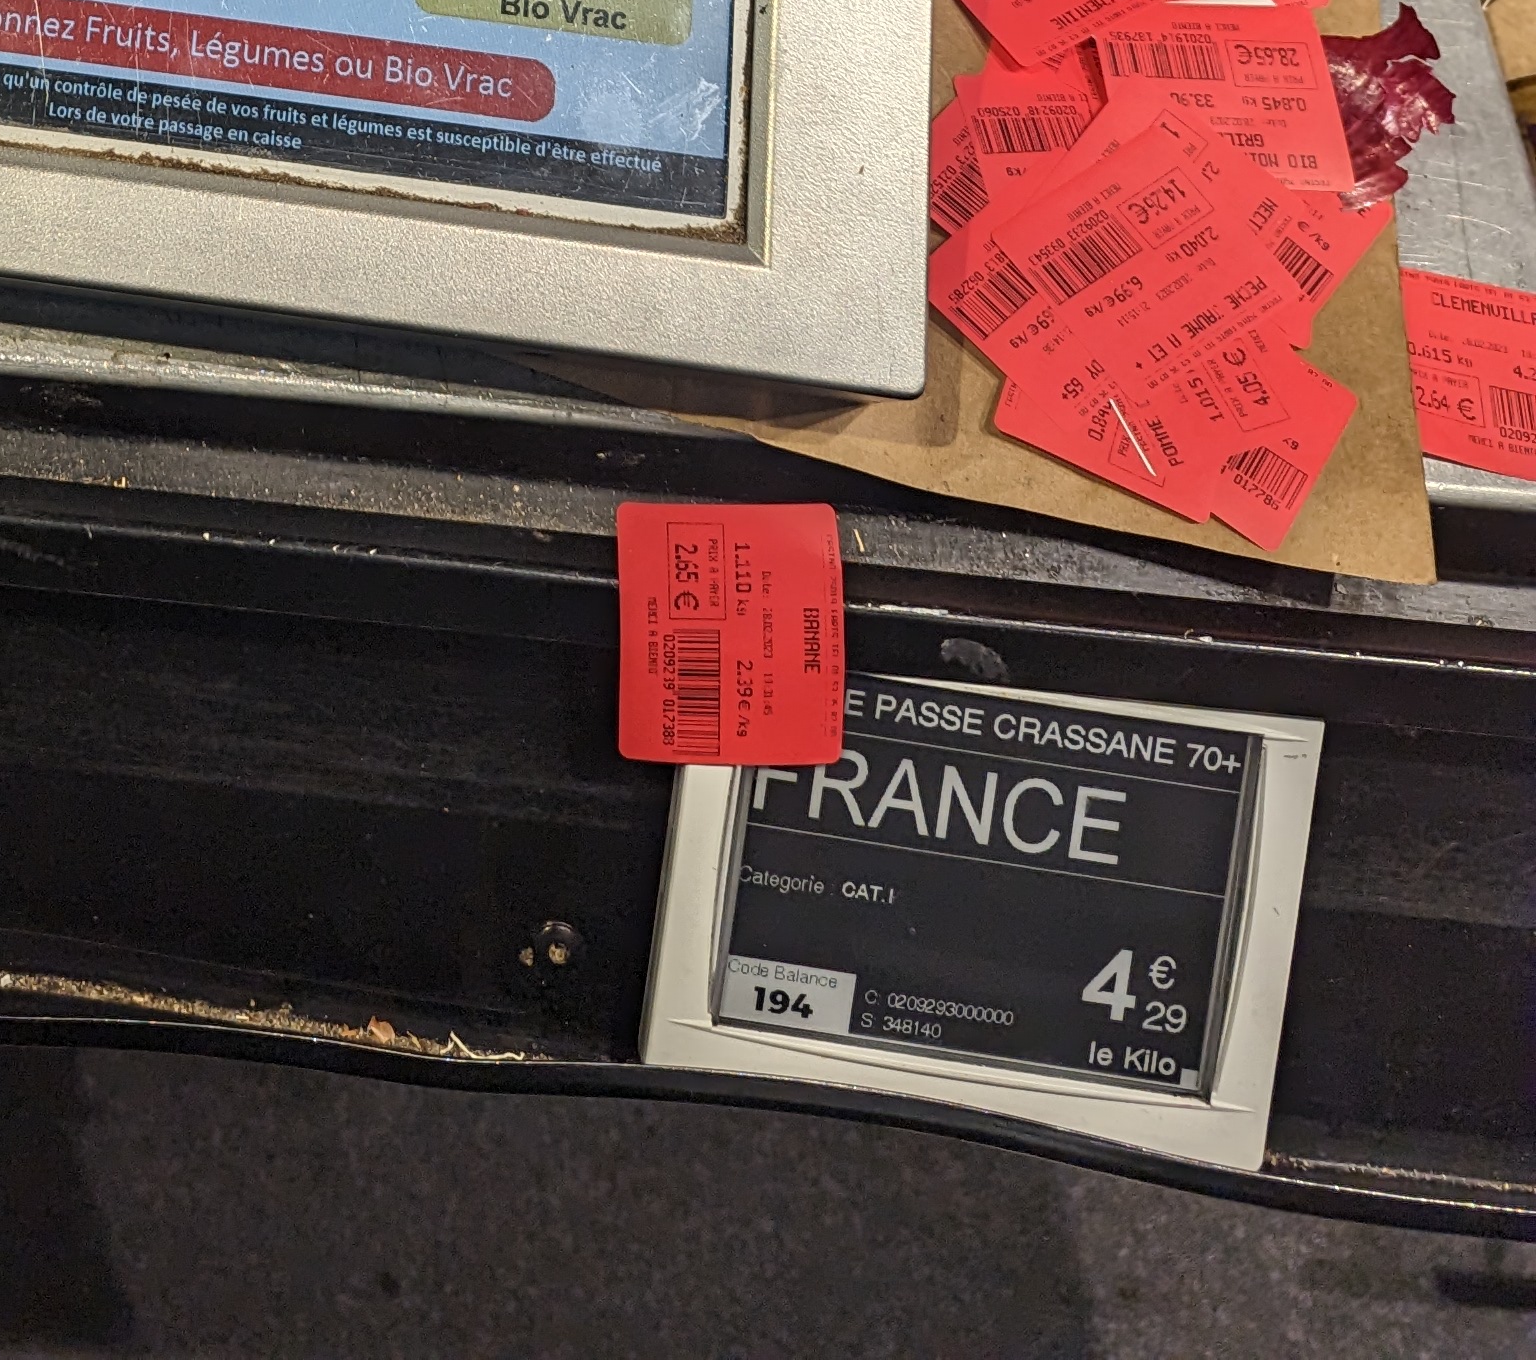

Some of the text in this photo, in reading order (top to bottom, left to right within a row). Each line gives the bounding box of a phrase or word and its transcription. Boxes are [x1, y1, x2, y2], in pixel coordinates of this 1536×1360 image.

[83, 16, 180, 60] Fruits,
[189, 28, 330, 80] Légumes
[334, 56, 373, 79] ou
[383, 55, 434, 87] Bio
[441, 63, 514, 98] Vrac
[2, 71, 50, 94] qu'un
[54, 76, 123, 101] contrôle
[125, 87, 148, 104] de
[149, 90, 203, 116] pesée
[205, 97, 227, 115] de
[229, 103, 260, 119] vos
[261, 105, 307, 125] fruits
[310, 112, 328, 128] et
[330, 114, 402, 142] légumes
[406, 126, 432, 142] est
[434, 127, 531, 159] susceptible
[533, 140, 587, 162] d'être
[589, 147, 662, 172] effectué
[48, 102, 303, 150] Lors de votre passage en caisse
[1259, 93, 1307, 112] 0.845
[1285, 152, 1318, 169] BIO
[1186, 372, 1225, 426] 1.015
[1221, 343, 1272, 411] 4.05 €
[1455, 397, 1478, 420] €
[1145, 415, 1185, 468] POMME
[673, 543, 699, 611] 2.65 €
[733, 542, 752, 593] 1.110
[800, 607, 822, 674] BANANE
[660, 698, 677, 746] 017388
[873, 693, 985, 736] PASSE
[991, 713, 1177, 765] CRASSANE
[1183, 742, 1242, 774] 70+
[748, 739, 1129, 865] FRANCE
[727, 957, 839, 990] Code Balance
[1079, 945, 1177, 1023] 4 €
[751, 986, 815, 1019] 194
[885, 992, 1014, 1026] 0209293000000
[1142, 1000, 1188, 1034] 29
[882, 1016, 941, 1040] 348140
[1088, 1041, 1176, 1075] le Kilo
